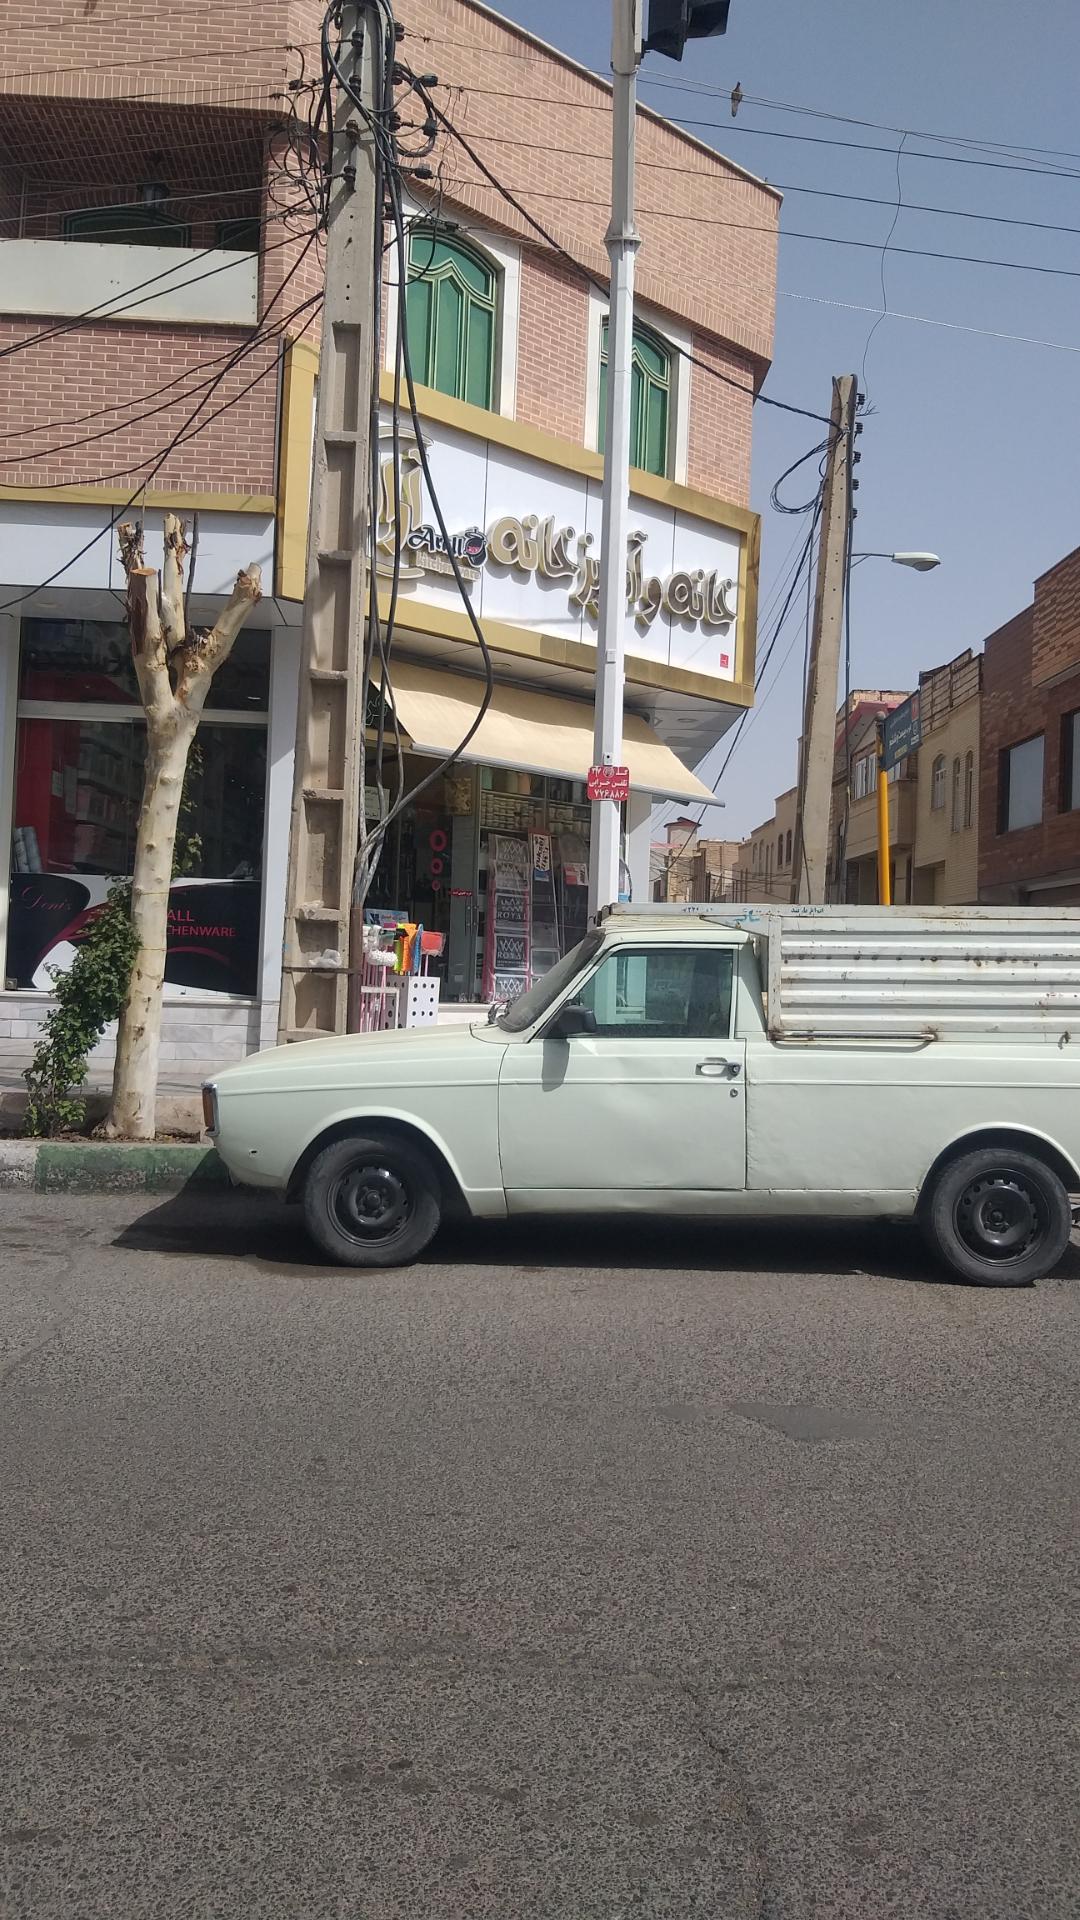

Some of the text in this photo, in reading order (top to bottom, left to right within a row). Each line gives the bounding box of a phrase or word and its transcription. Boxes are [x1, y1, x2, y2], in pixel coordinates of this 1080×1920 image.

[489, 514, 648, 606] آزخانه
[667, 568, 738, 625] خانه
[167, 909, 195, 922] ALL
